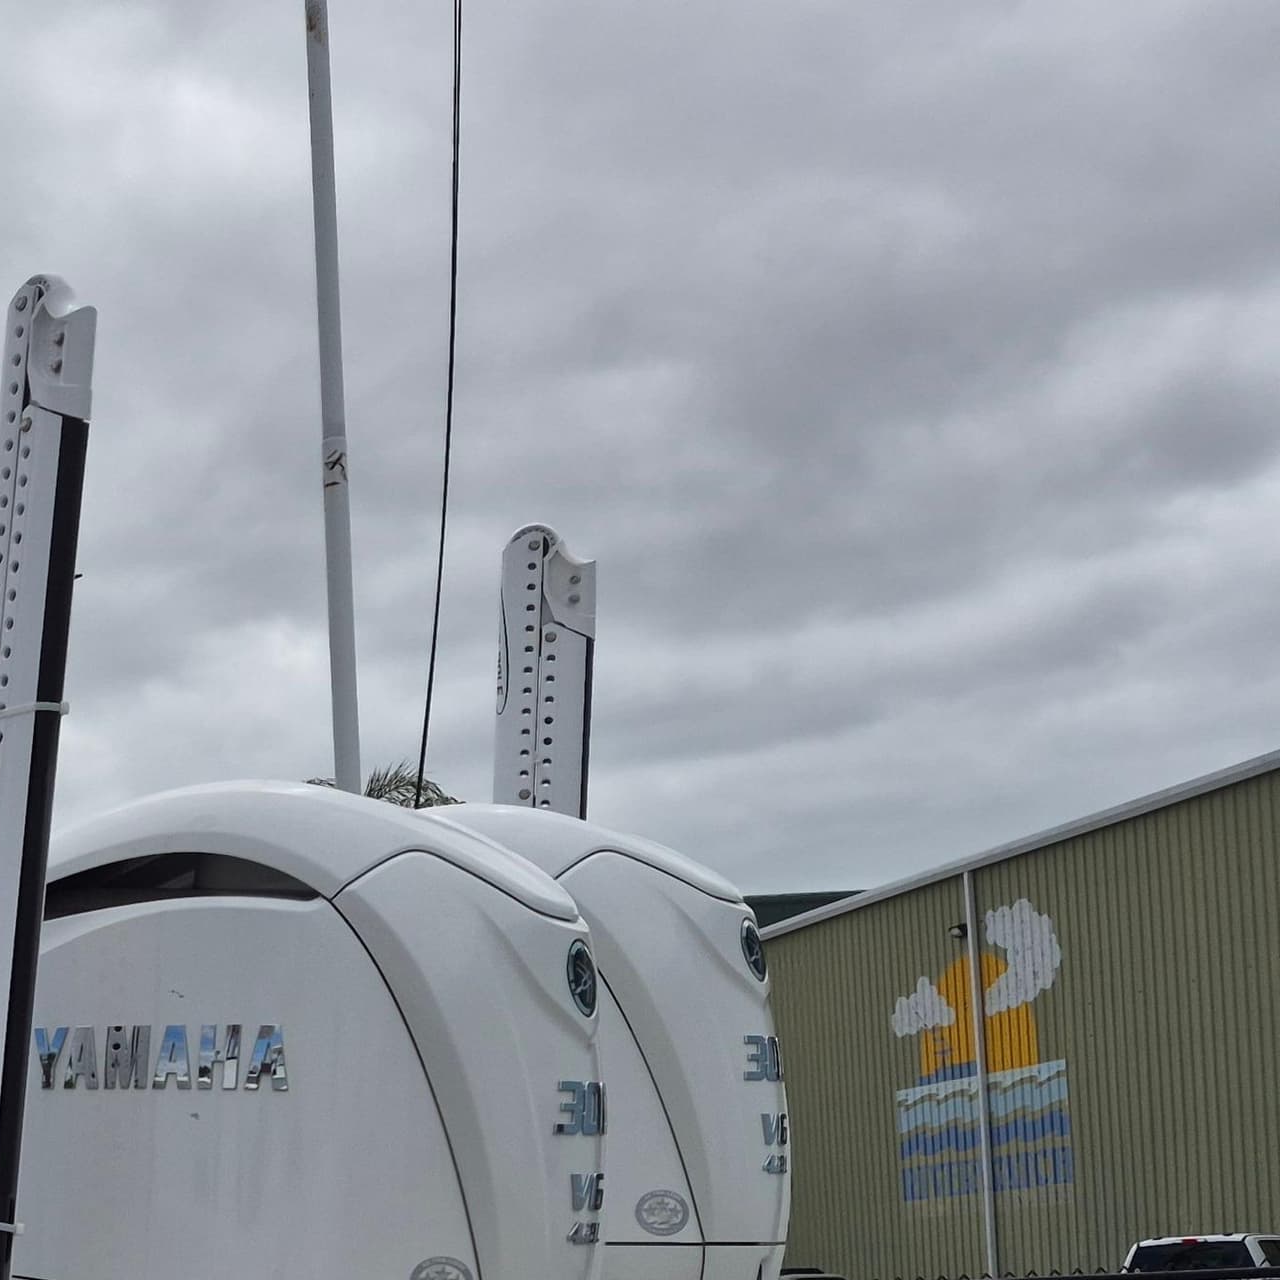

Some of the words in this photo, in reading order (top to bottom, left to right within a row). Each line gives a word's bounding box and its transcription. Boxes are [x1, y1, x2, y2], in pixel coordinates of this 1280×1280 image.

[34, 1024, 289, 1090] YAMAHA
[744, 1035, 784, 1081] 30
[553, 1081, 606, 1136] 30
[571, 1173, 605, 1212] V6
